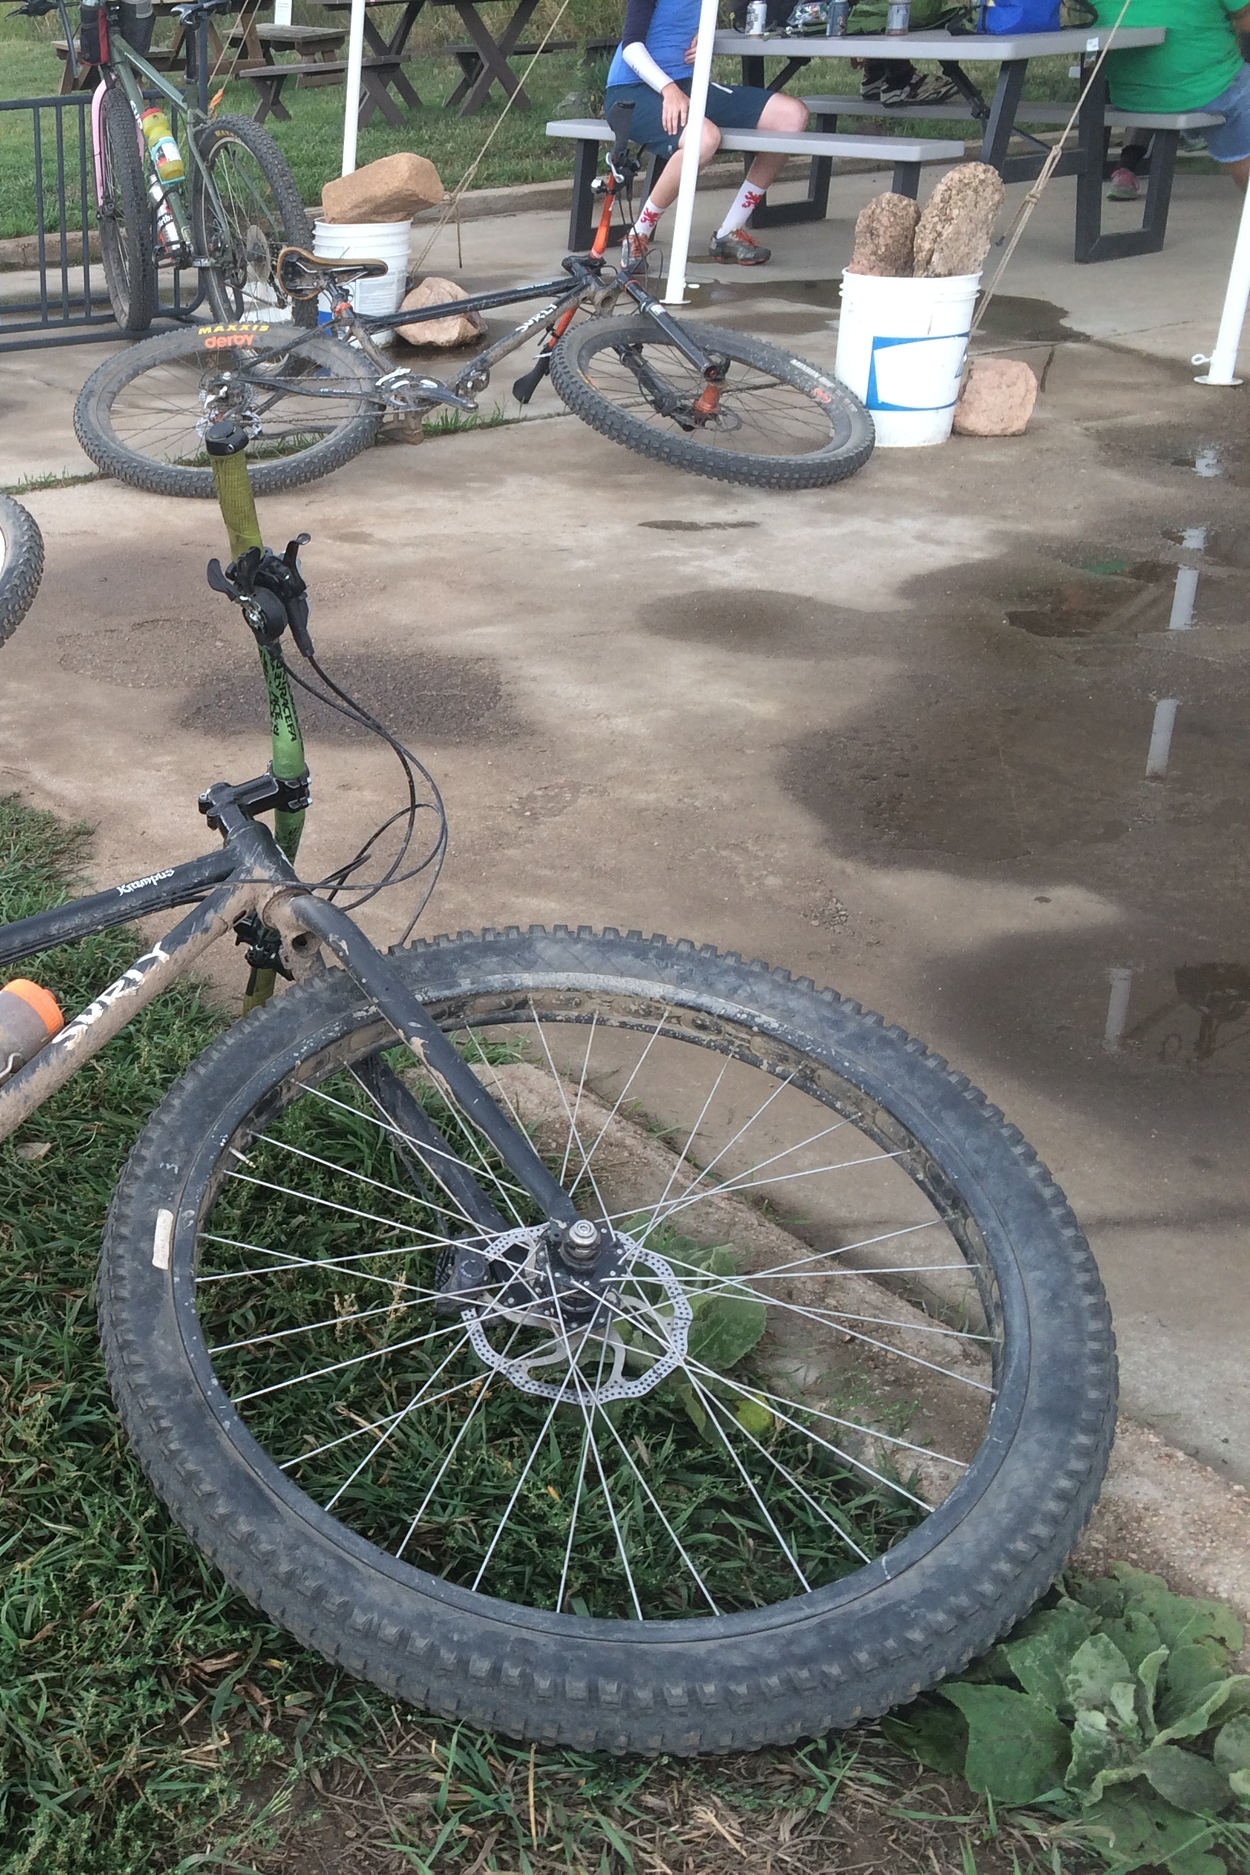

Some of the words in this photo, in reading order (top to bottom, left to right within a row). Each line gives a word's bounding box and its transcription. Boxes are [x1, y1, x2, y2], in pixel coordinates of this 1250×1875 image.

[198, 324, 269, 335] MAXXIS
[204, 334, 255, 349] derby
[116, 869, 175, 897] Krampus
